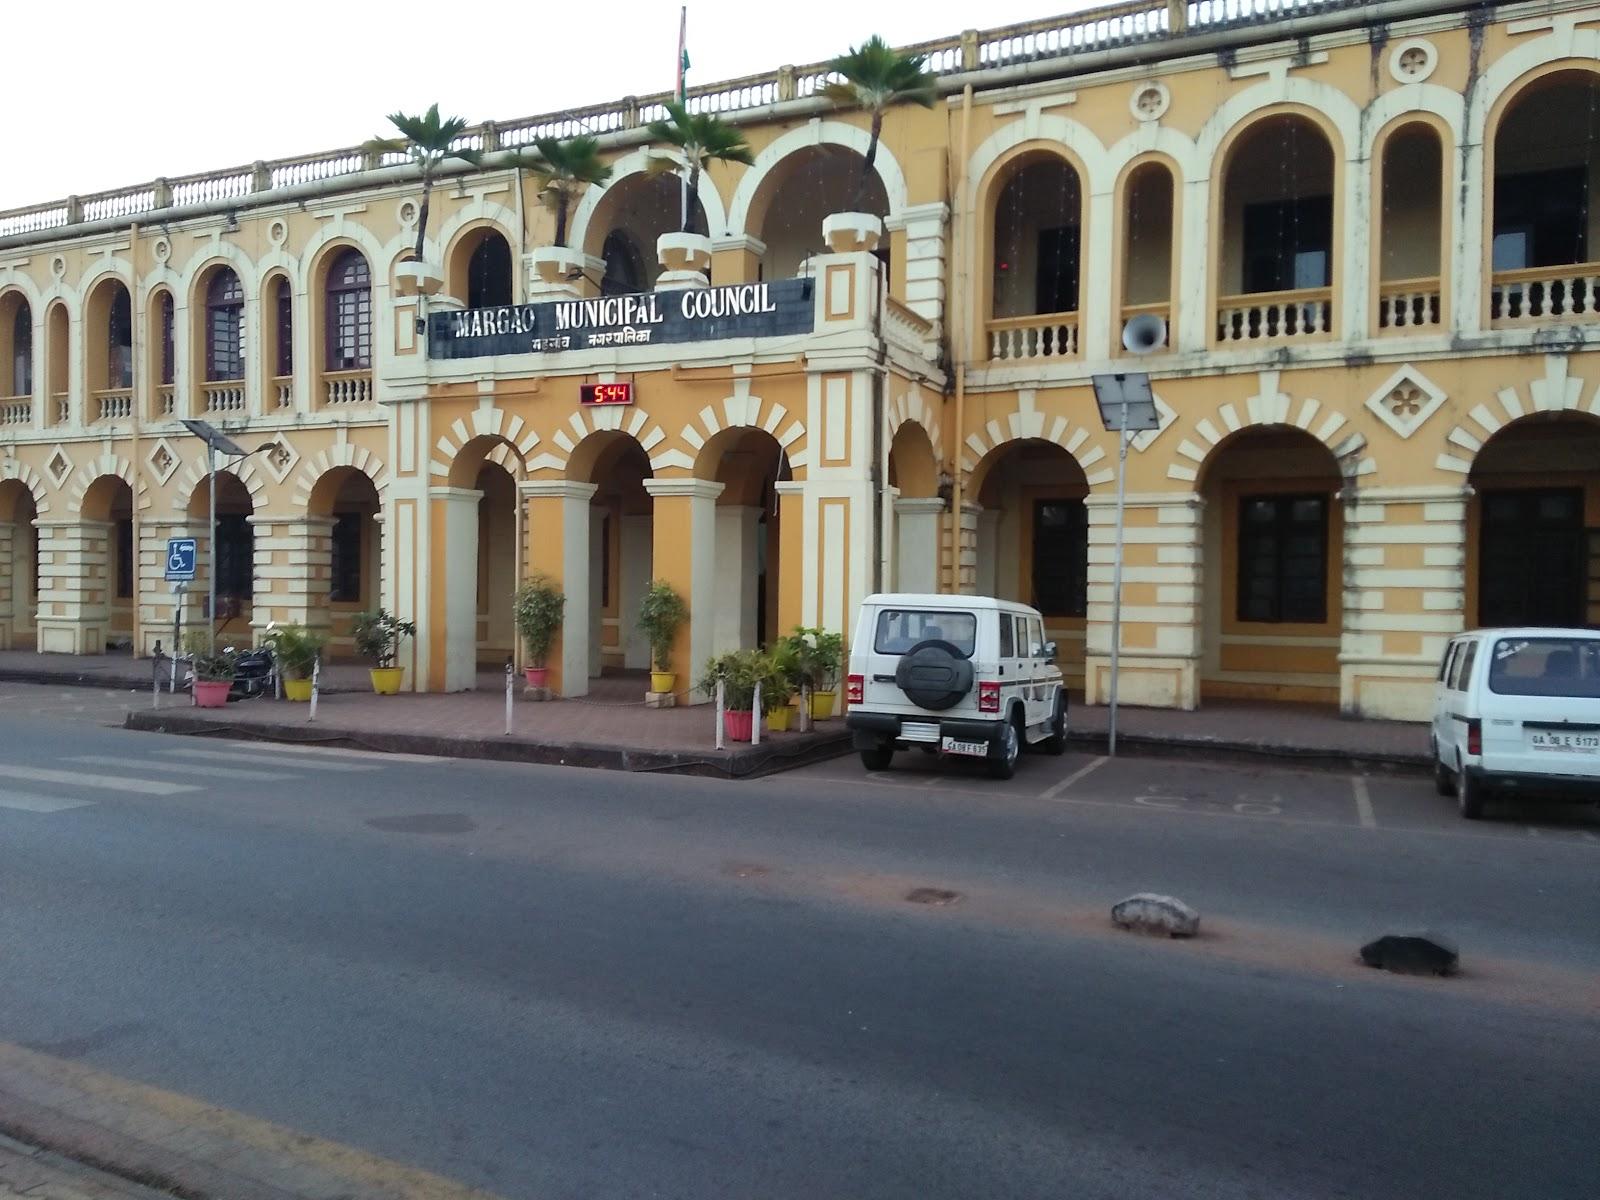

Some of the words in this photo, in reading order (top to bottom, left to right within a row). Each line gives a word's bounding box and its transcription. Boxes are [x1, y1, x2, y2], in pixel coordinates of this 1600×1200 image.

[455, 307, 535, 337] MARGAO
[555, 294, 663, 331] MUNICIPAL
[681, 283, 776, 319] COUNCIL
[594, 385, 627, 402] 5:44
